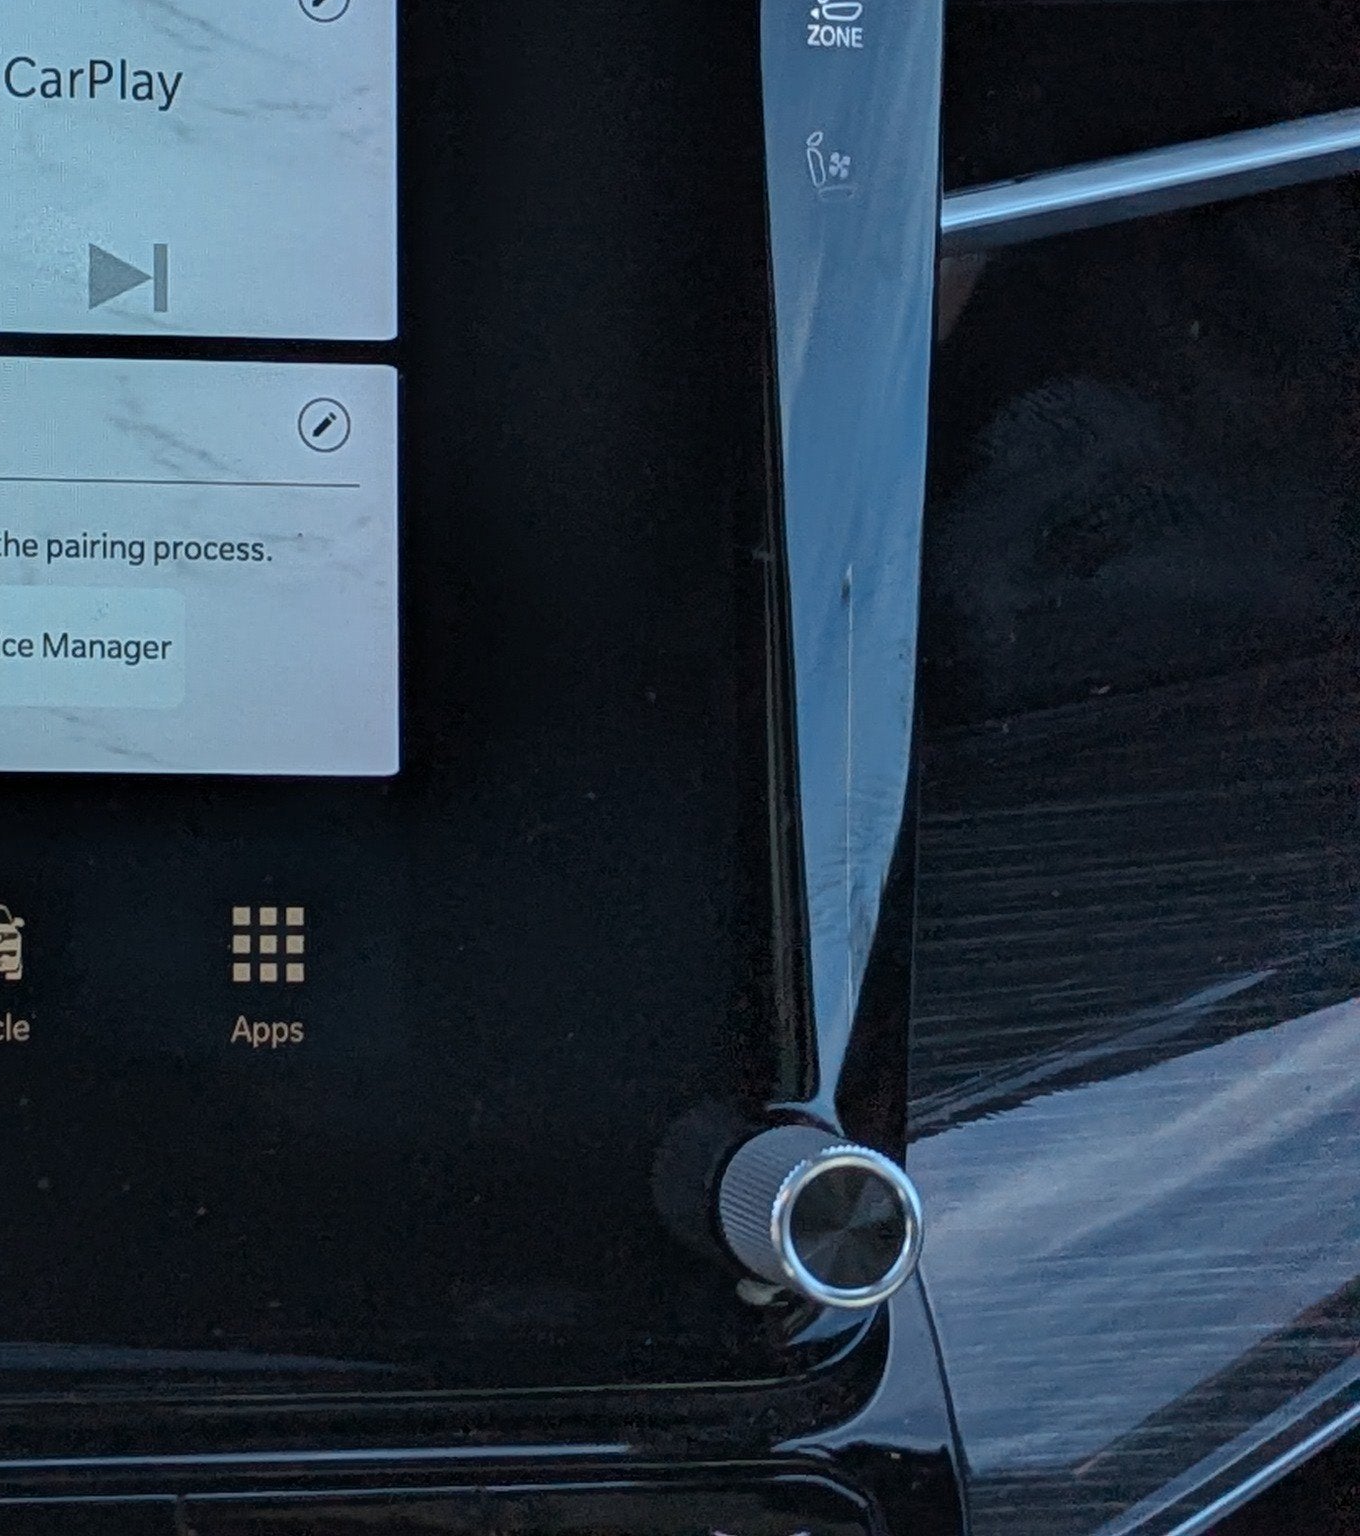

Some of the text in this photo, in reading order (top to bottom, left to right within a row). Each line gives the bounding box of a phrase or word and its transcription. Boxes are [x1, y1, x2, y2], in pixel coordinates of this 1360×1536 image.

[807, 25, 863, 48] ZONE
[5, 57, 184, 110] CarPlay
[46, 532, 146, 568] pairing
[152, 538, 274, 570] process.
[42, 632, 172, 667] Manager
[231, 1016, 305, 1047] Apps
